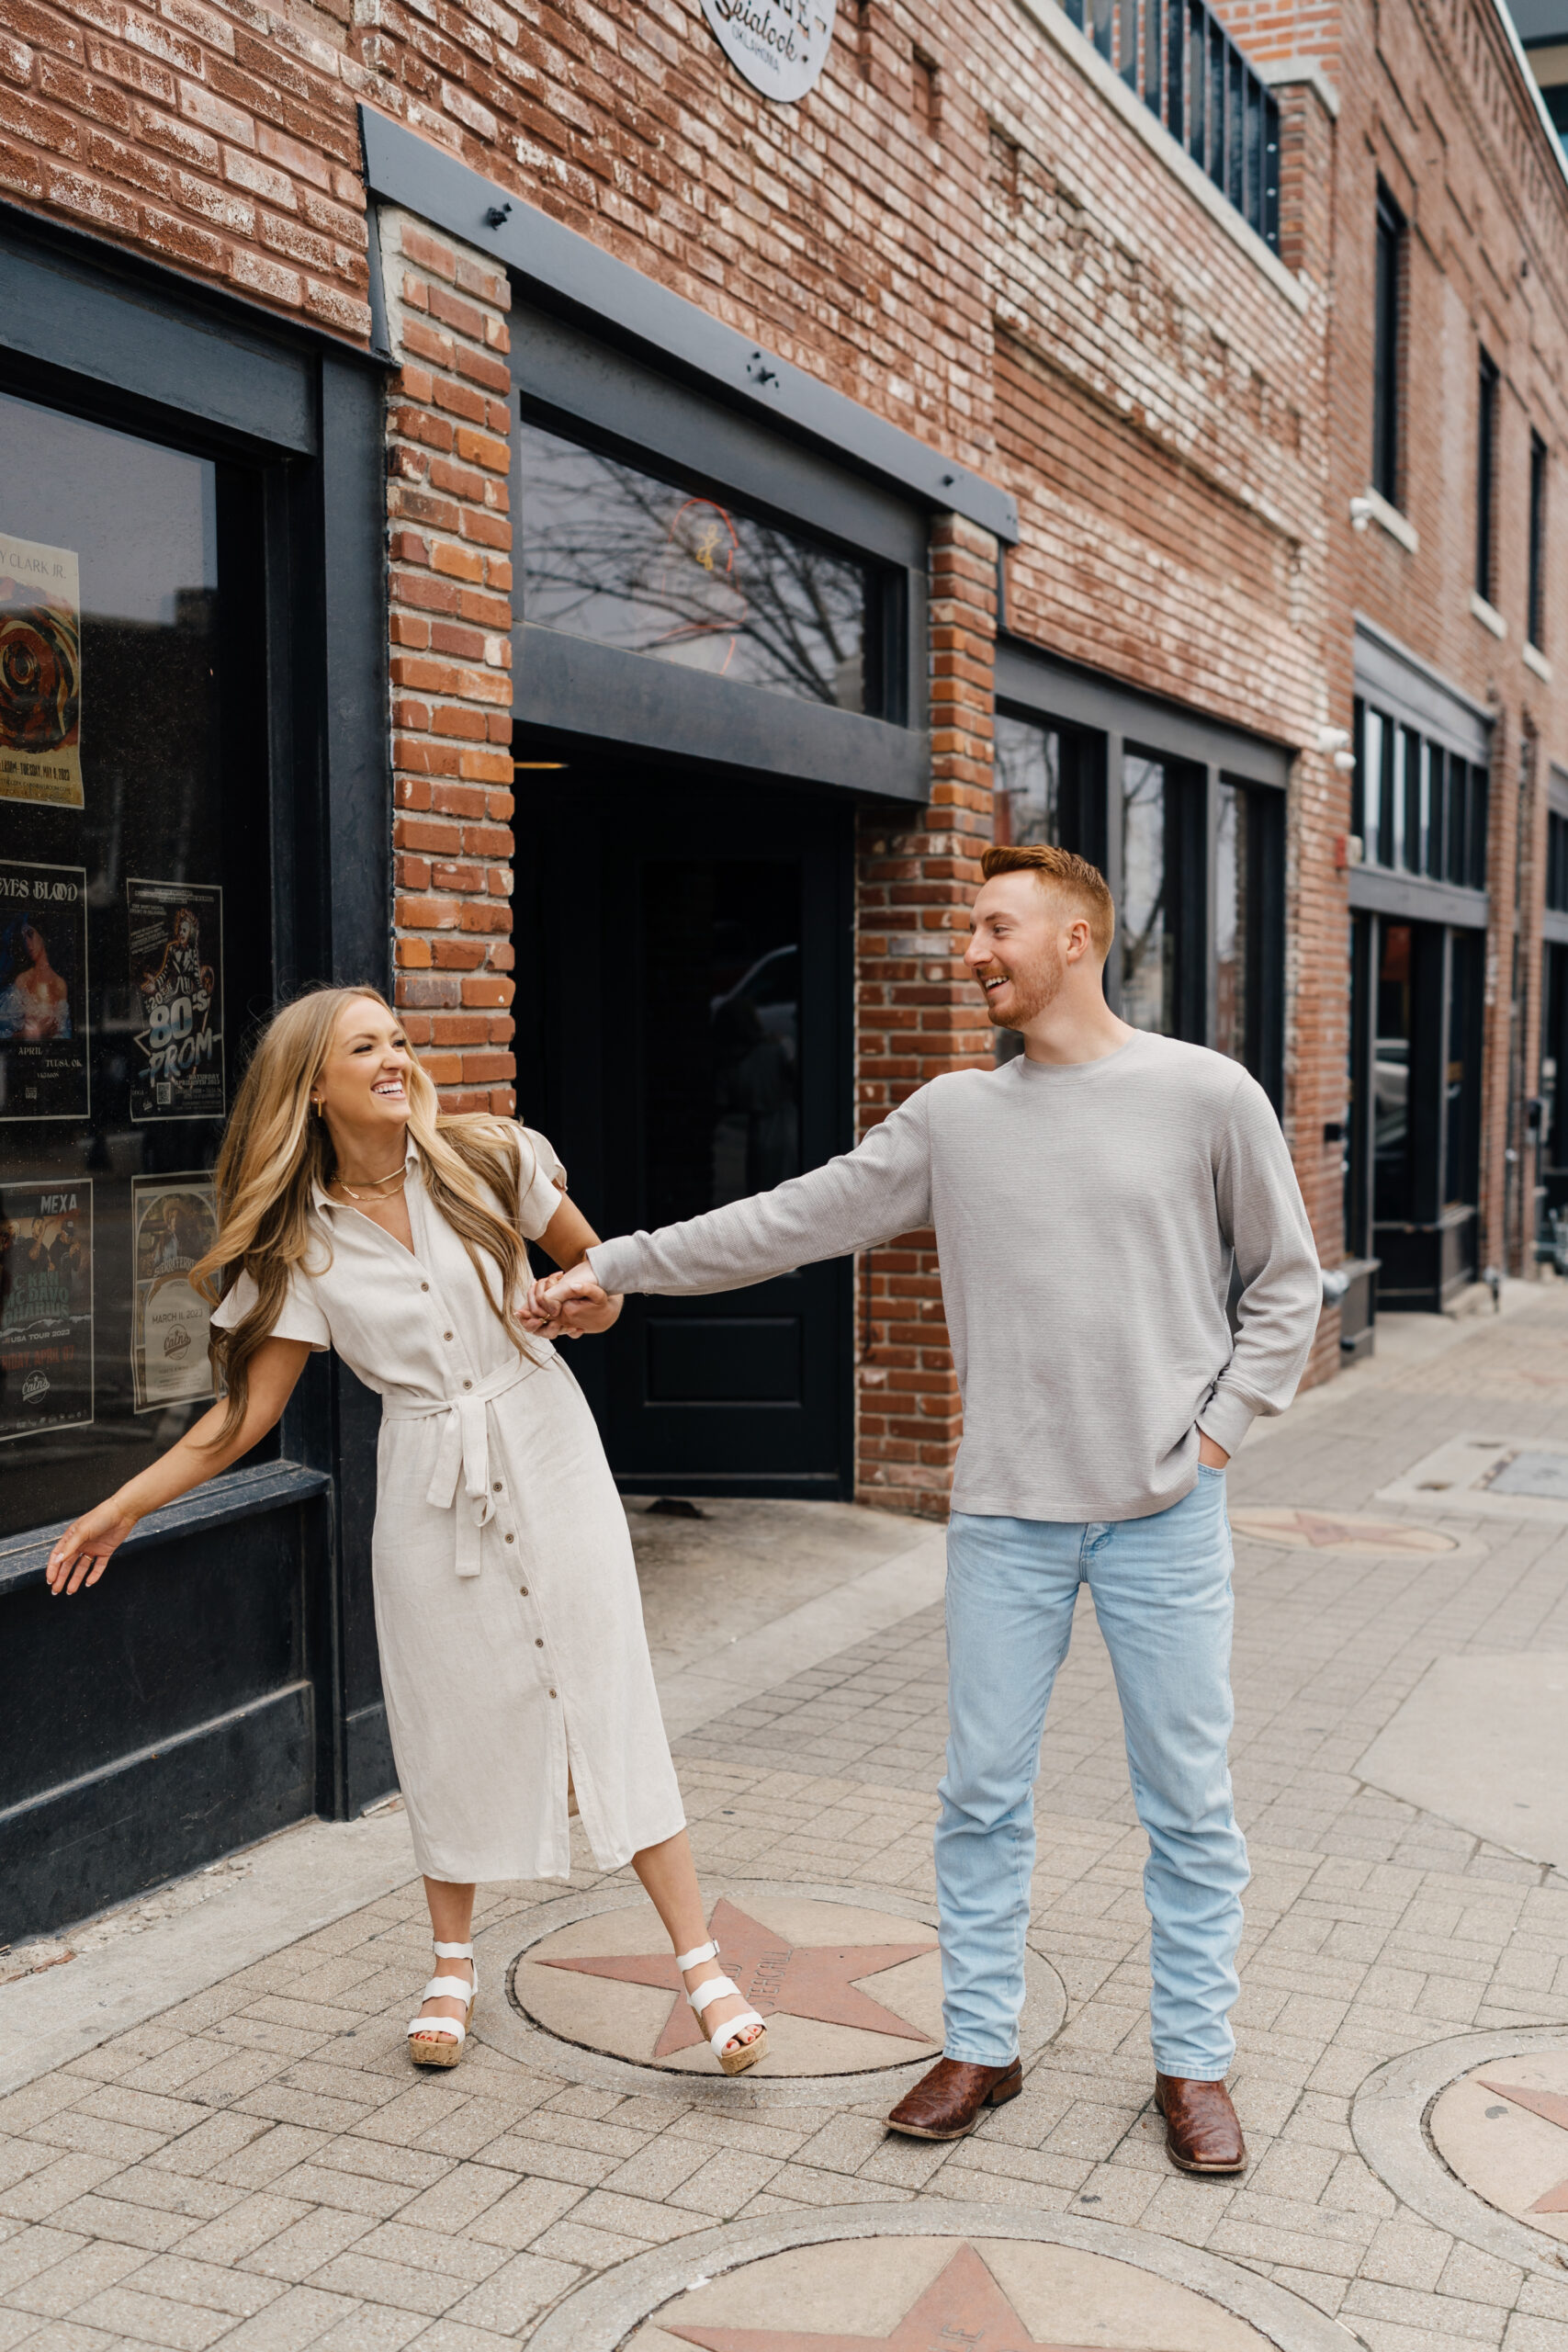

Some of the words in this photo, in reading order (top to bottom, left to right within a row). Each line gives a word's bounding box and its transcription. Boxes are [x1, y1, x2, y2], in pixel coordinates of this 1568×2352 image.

[9, 552, 50, 575] CLARK
[52, 562, 66, 579] JR.
[33, 881, 78, 901] BLOOD
[17, 1046, 43, 1056] APRIL
[149, 1027, 212, 1088] PROM
[152, 1313, 177, 1324] MARCH
[11, 1335, 27, 1343] USA
[28, 1331, 51, 1340] TOUR
[34, 1346, 60, 1366] APRIL
